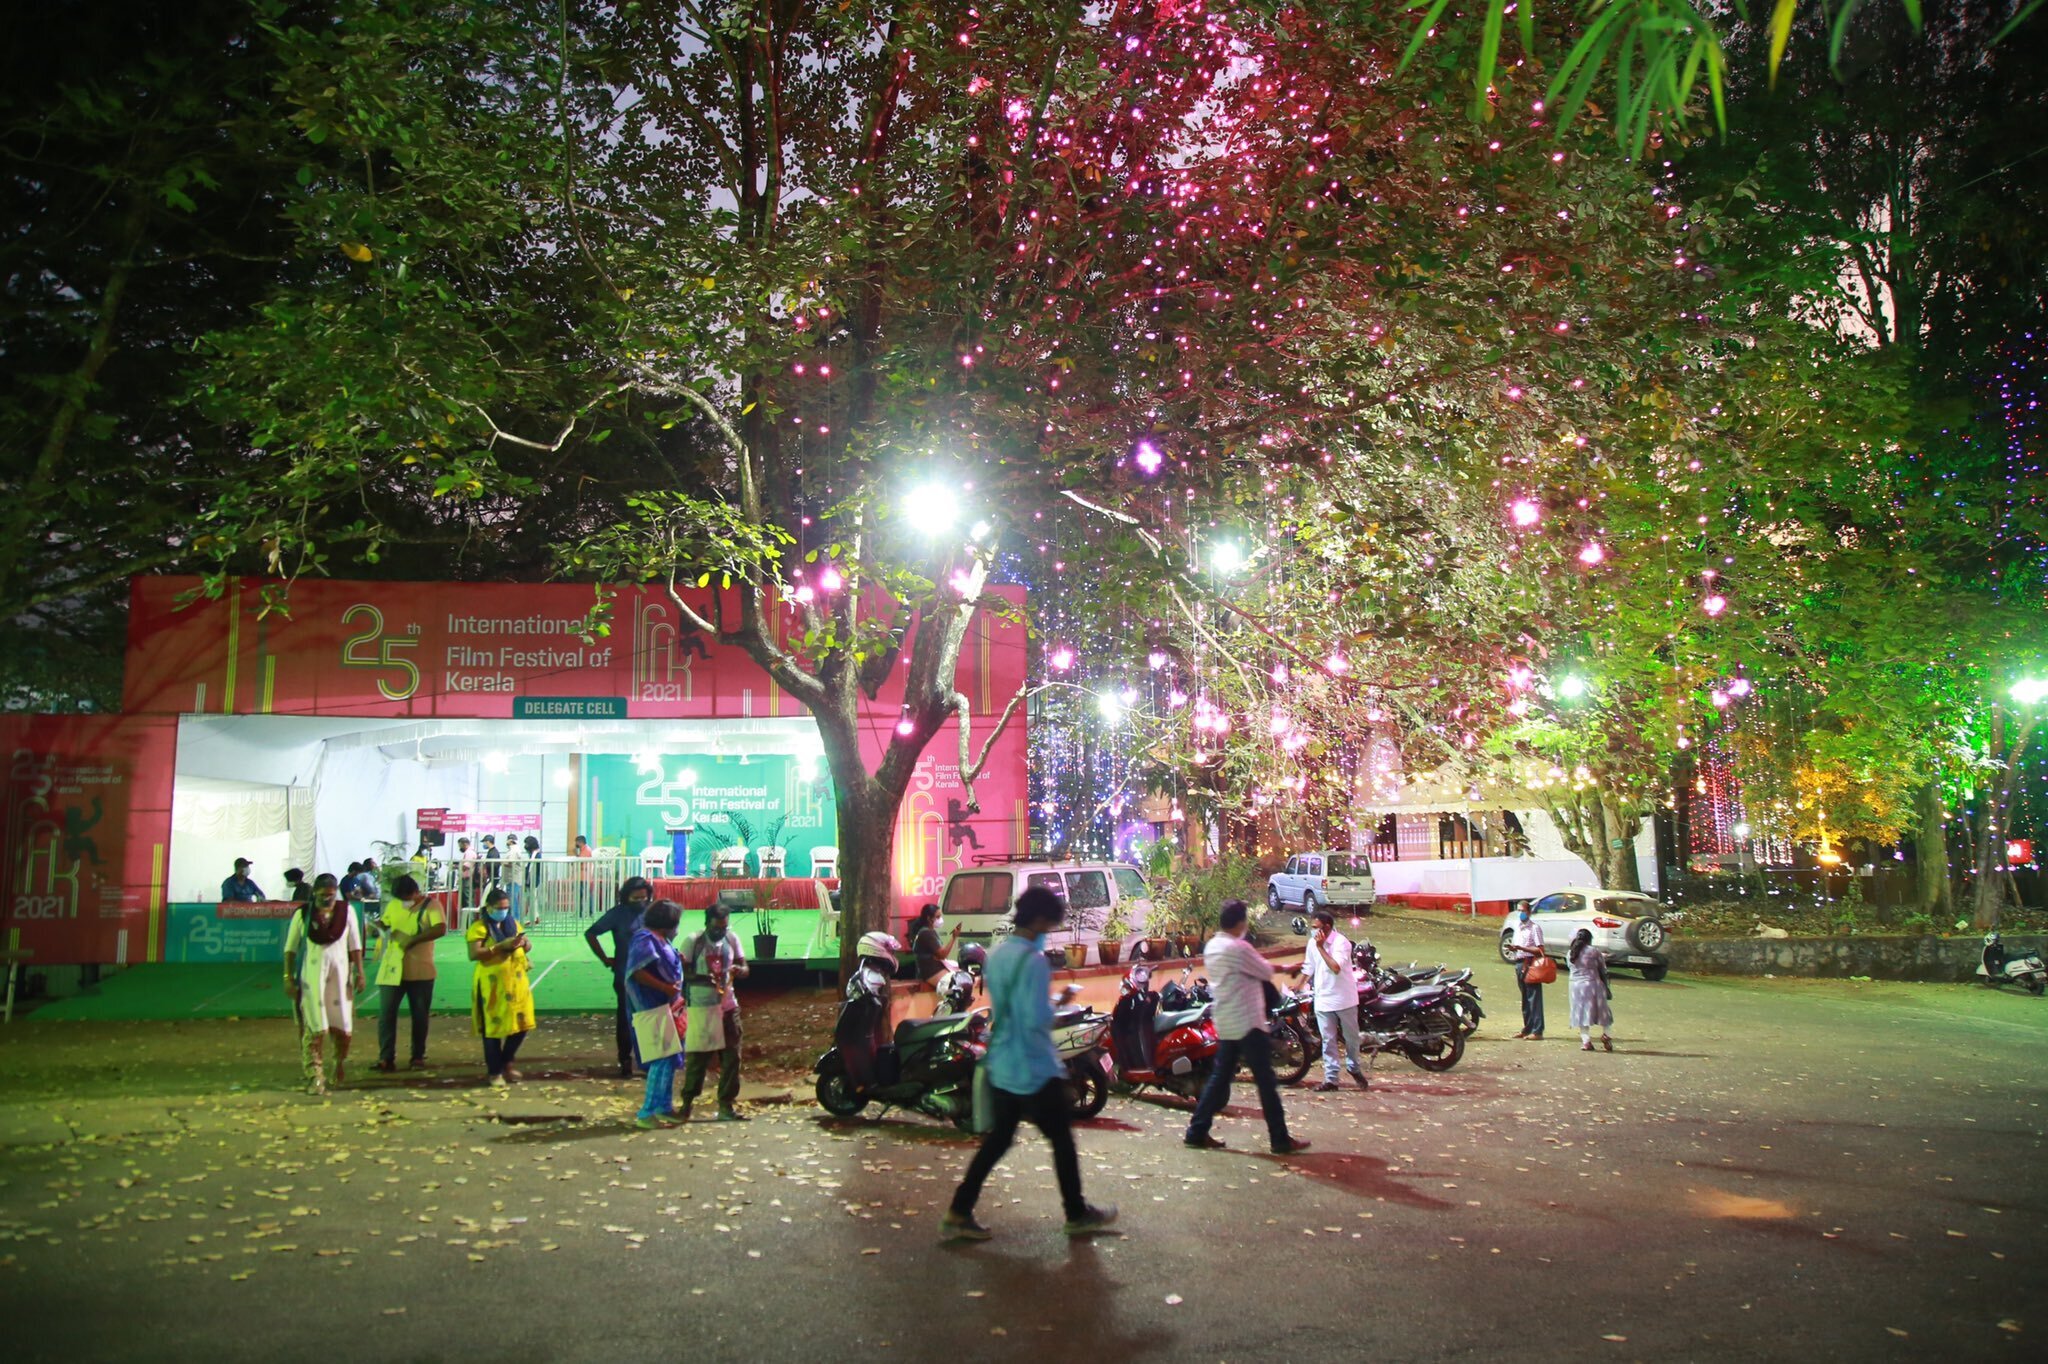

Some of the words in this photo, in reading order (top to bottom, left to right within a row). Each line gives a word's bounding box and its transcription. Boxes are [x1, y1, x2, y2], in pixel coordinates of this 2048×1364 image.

[446, 646, 494, 667] Film
[500, 647, 584, 667] Festival
[589, 647, 612, 667] of
[445, 671, 515, 692] Kerala
[642, 683, 681, 702] 2021
[524, 701, 584, 716] DELEGATE
[588, 702, 616, 716] CELL
[911, 761, 934, 790] 5
[935, 772, 952, 780] Film
[982, 771, 991, 780] of
[636, 761, 689, 826] 25
[692, 785, 767, 797] International
[692, 798, 718, 810] Film
[720, 798, 765, 810] Festival
[767, 798, 780, 810] of
[791, 816, 816, 827] 2021
[912, 876, 946, 896] 202
[13, 896, 64, 918] 2021
